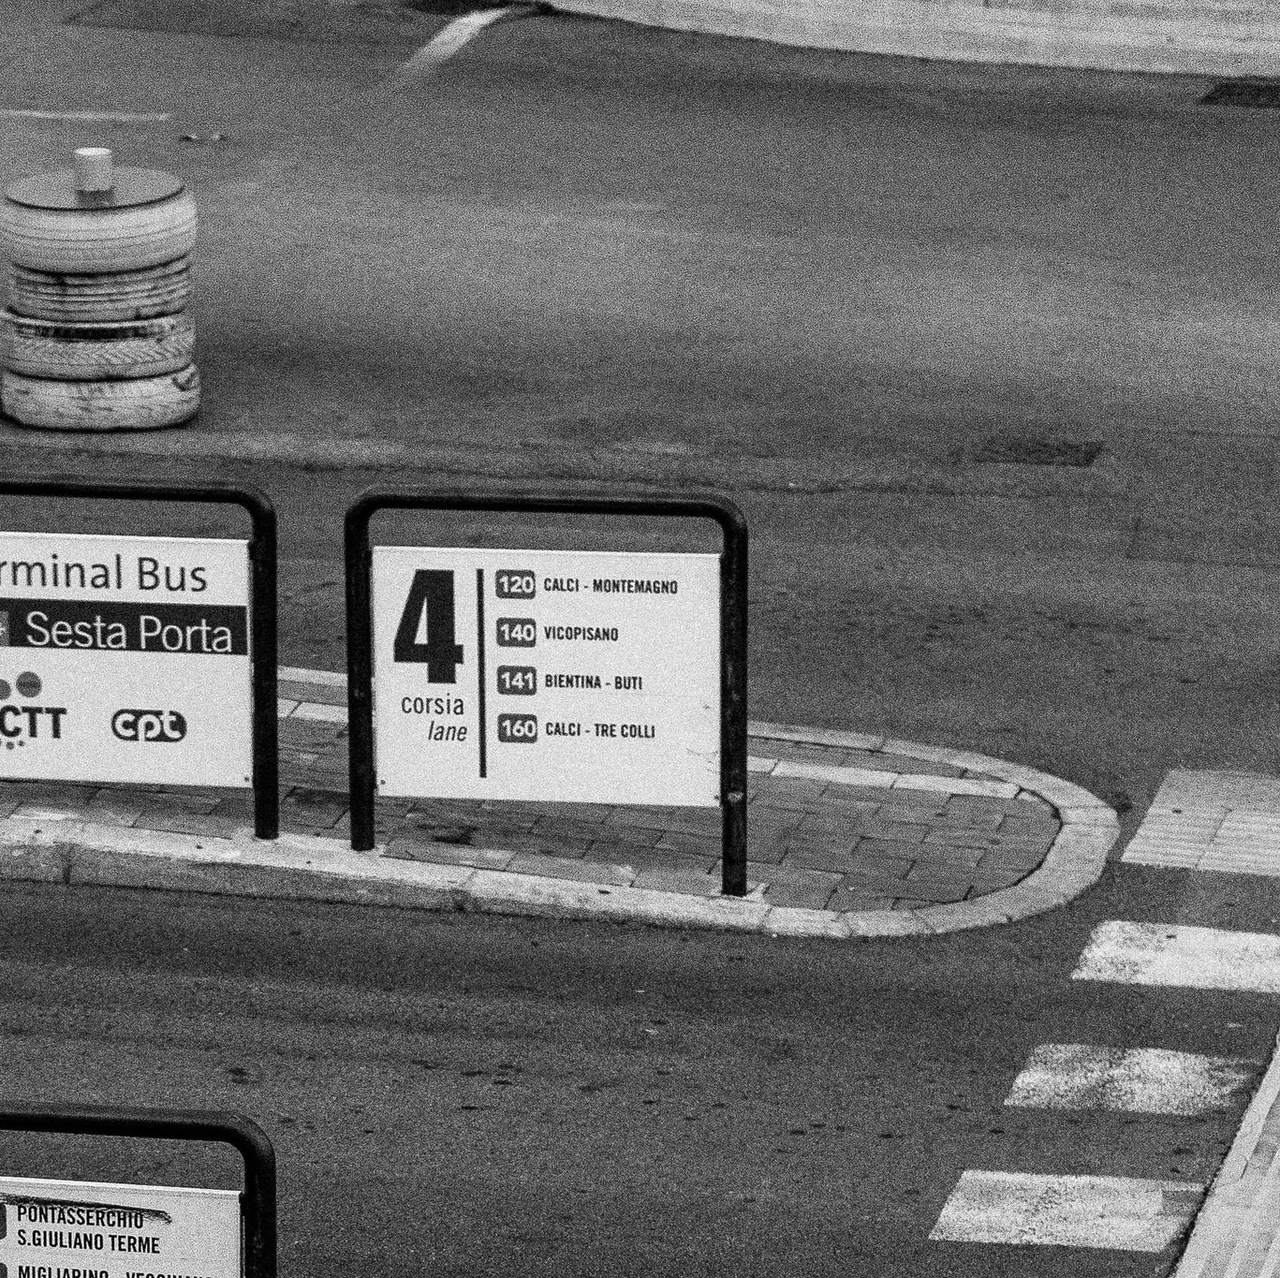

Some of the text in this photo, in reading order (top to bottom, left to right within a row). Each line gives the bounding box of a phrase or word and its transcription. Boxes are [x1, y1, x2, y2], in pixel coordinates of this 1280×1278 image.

[137, 556, 207, 592] Bus
[498, 575, 535, 594] 120
[543, 577, 579, 593] CALCI
[592, 578, 678, 595] MONTEMAGNO
[26, 610, 232, 653] Sesta Porta
[393, 568, 464, 685] 4
[500, 623, 536, 642] 140
[543, 625, 619, 642] VICOPISANO
[501, 671, 536, 690] 141
[545, 673, 602, 689] BIENTINA
[614, 675, 643, 691] BUTI
[401, 692, 464, 716] corsia
[112, 709, 187, 743] cpt
[427, 720, 468, 742] lane
[501, 719, 538, 738] 160
[546, 722, 581, 737] CALCI
[594, 723, 617, 738] TRE
[620, 724, 656, 739] COLLI
[17, 1205, 144, 1230] PONTASSERCHIO
[17, 1229, 161, 1255] S.GIULIANO TERME
